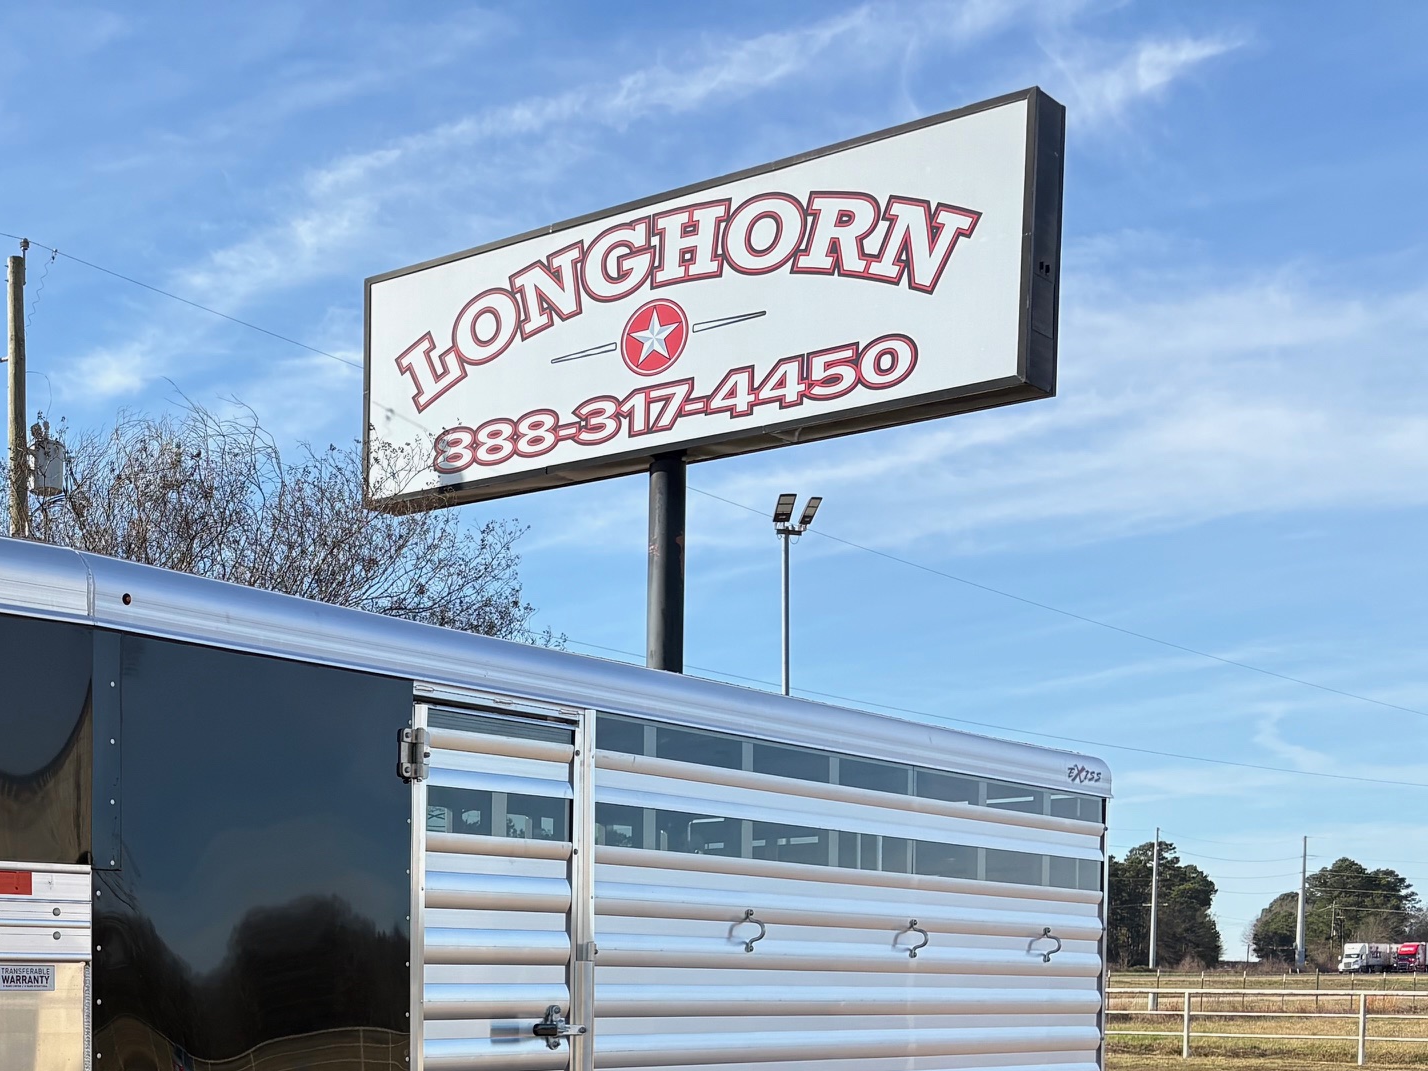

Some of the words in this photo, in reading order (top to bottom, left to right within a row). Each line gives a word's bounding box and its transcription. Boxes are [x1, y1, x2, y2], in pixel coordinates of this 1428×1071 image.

[395, 190, 981, 413] LONGHORN
[434, 333, 918, 474] 888-317-4450
[1067, 764, 1102, 783] EXISS
[1, 967, 50, 975] TRANSFERABLE
[1, 975, 50, 984] WARRANTY
